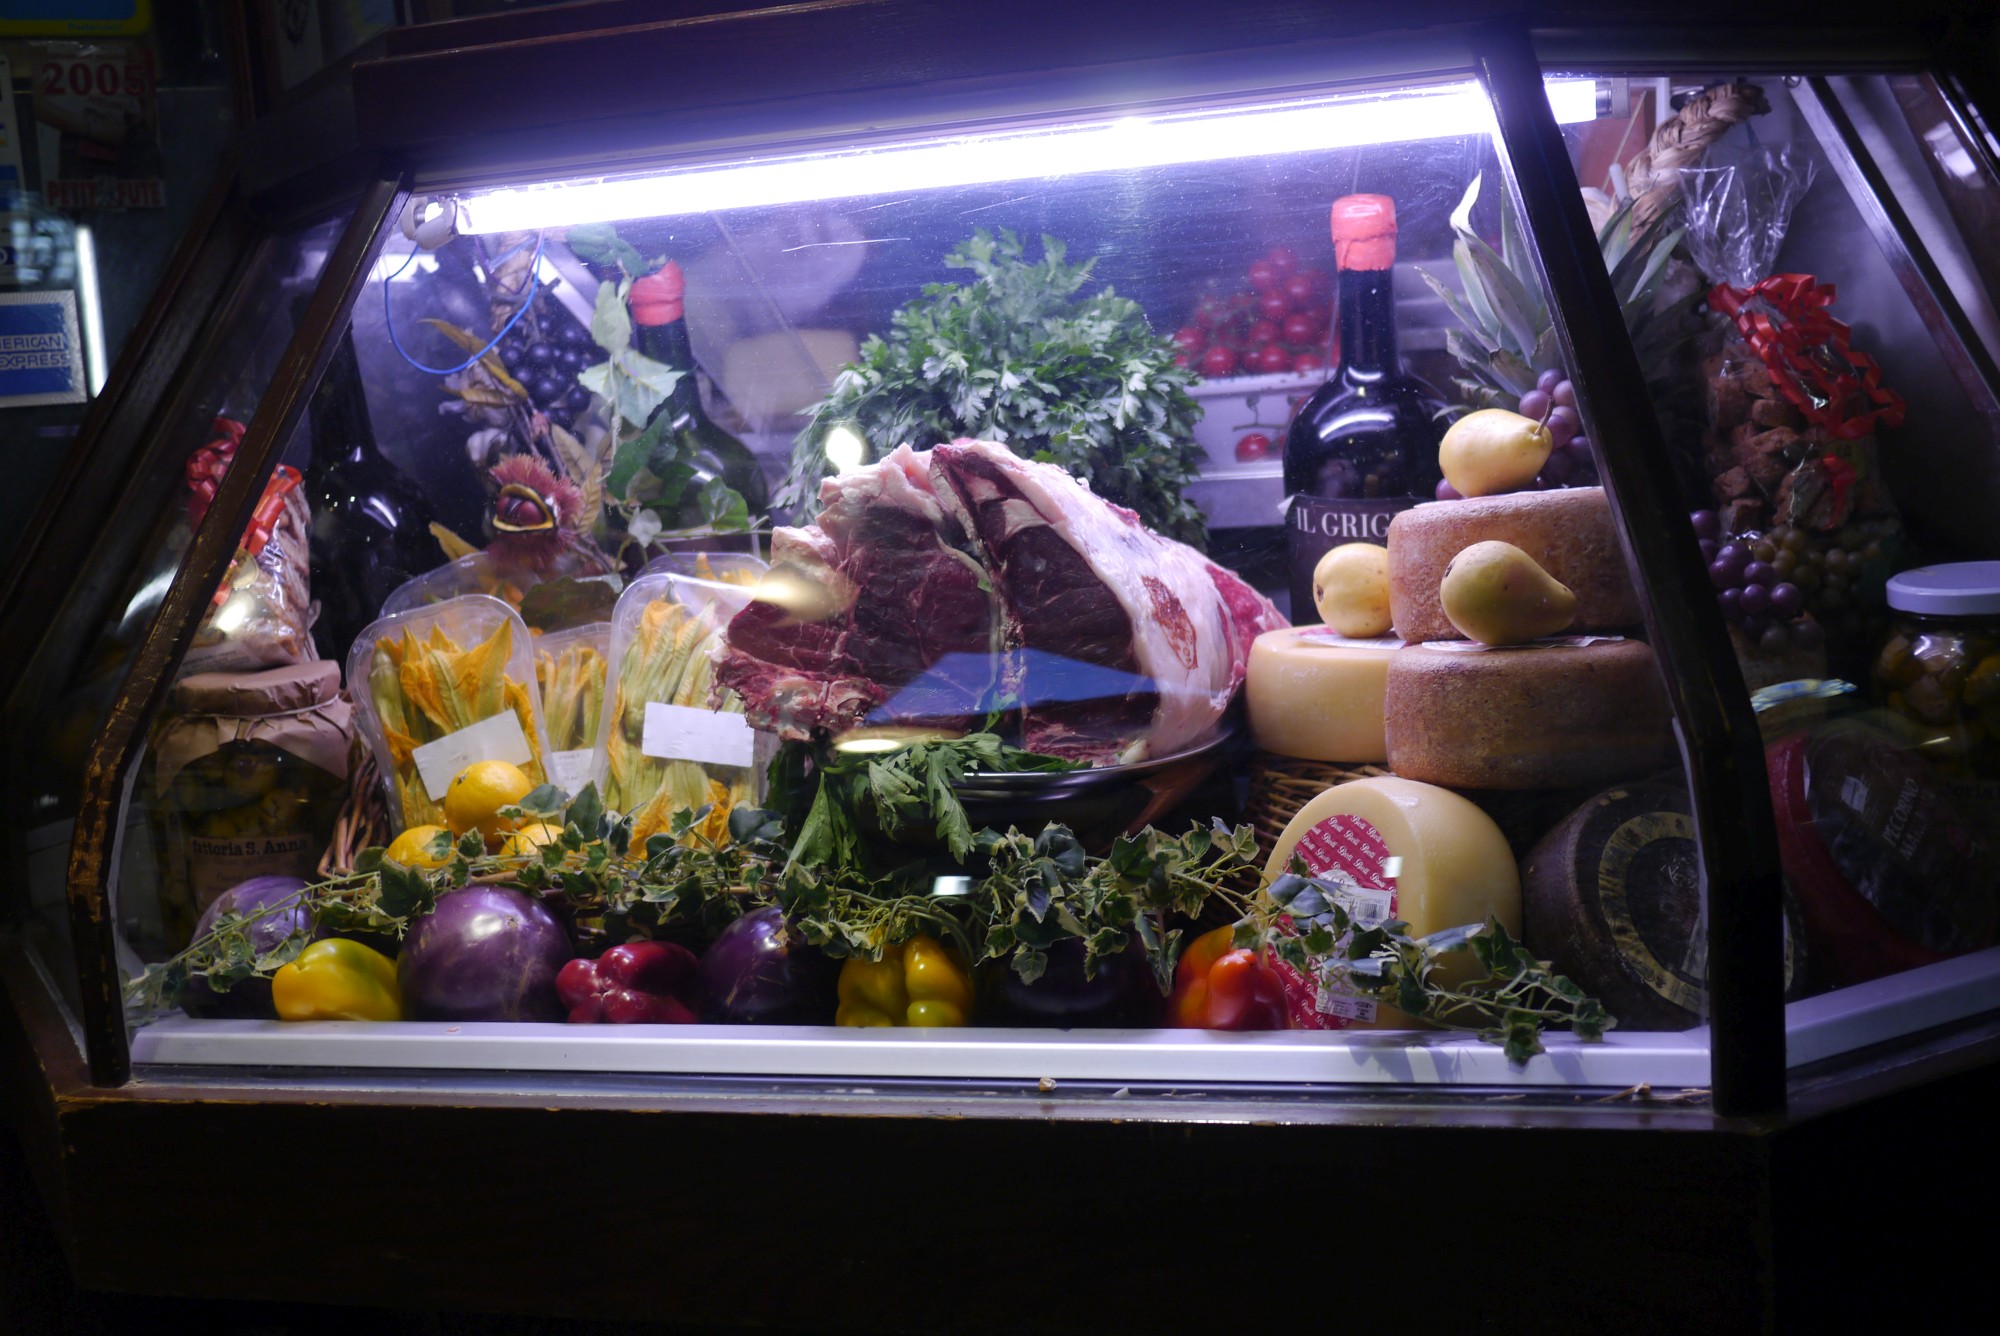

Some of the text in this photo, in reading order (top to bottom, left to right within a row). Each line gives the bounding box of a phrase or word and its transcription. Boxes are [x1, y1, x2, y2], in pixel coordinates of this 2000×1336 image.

[42, 62, 146, 96] 2005
[47, 180, 97, 208] PETIT
[0, 336, 61, 350] ERICAN
[1295, 506, 1398, 538] IL GRIG
[192, 838, 308, 856] fattoria S. Anna
